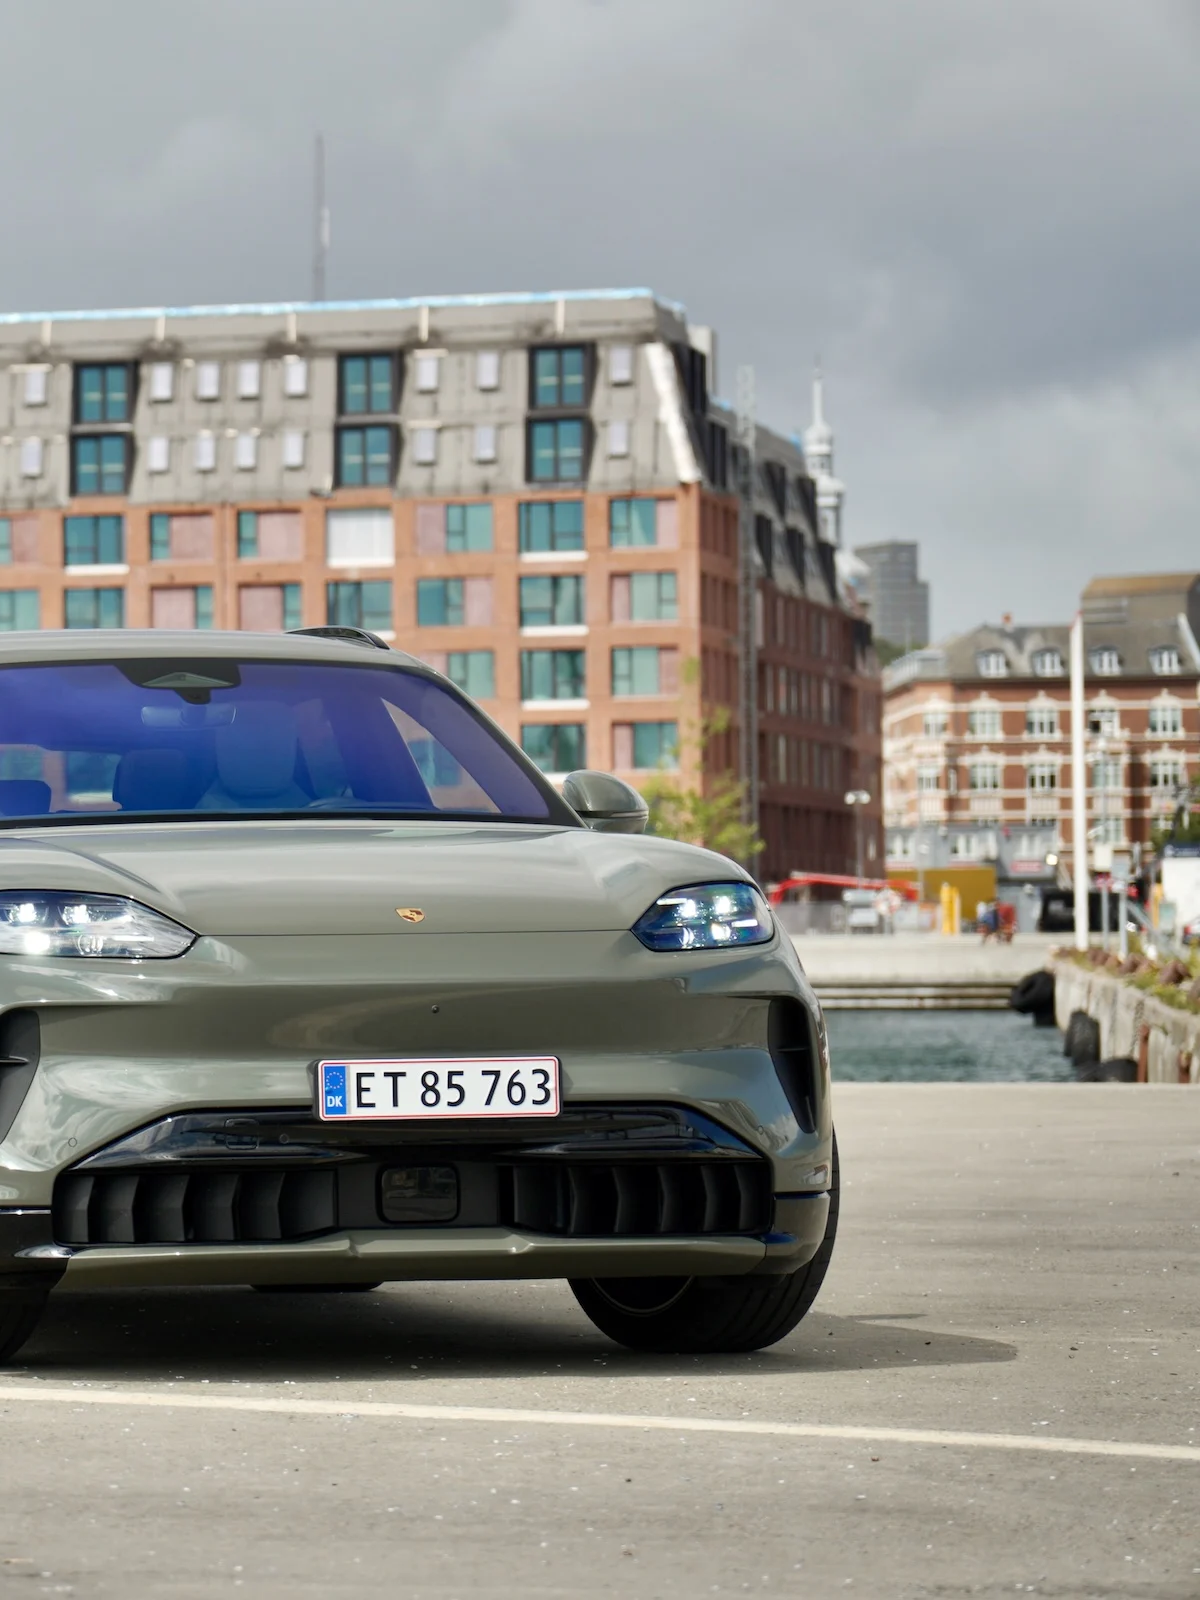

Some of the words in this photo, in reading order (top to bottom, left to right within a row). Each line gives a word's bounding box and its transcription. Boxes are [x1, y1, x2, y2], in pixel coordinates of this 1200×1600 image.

[356, 1072, 406, 1108] ET
[420, 1070, 466, 1107] 85
[481, 1069, 551, 1106] 763
[327, 1096, 343, 1108] DK
